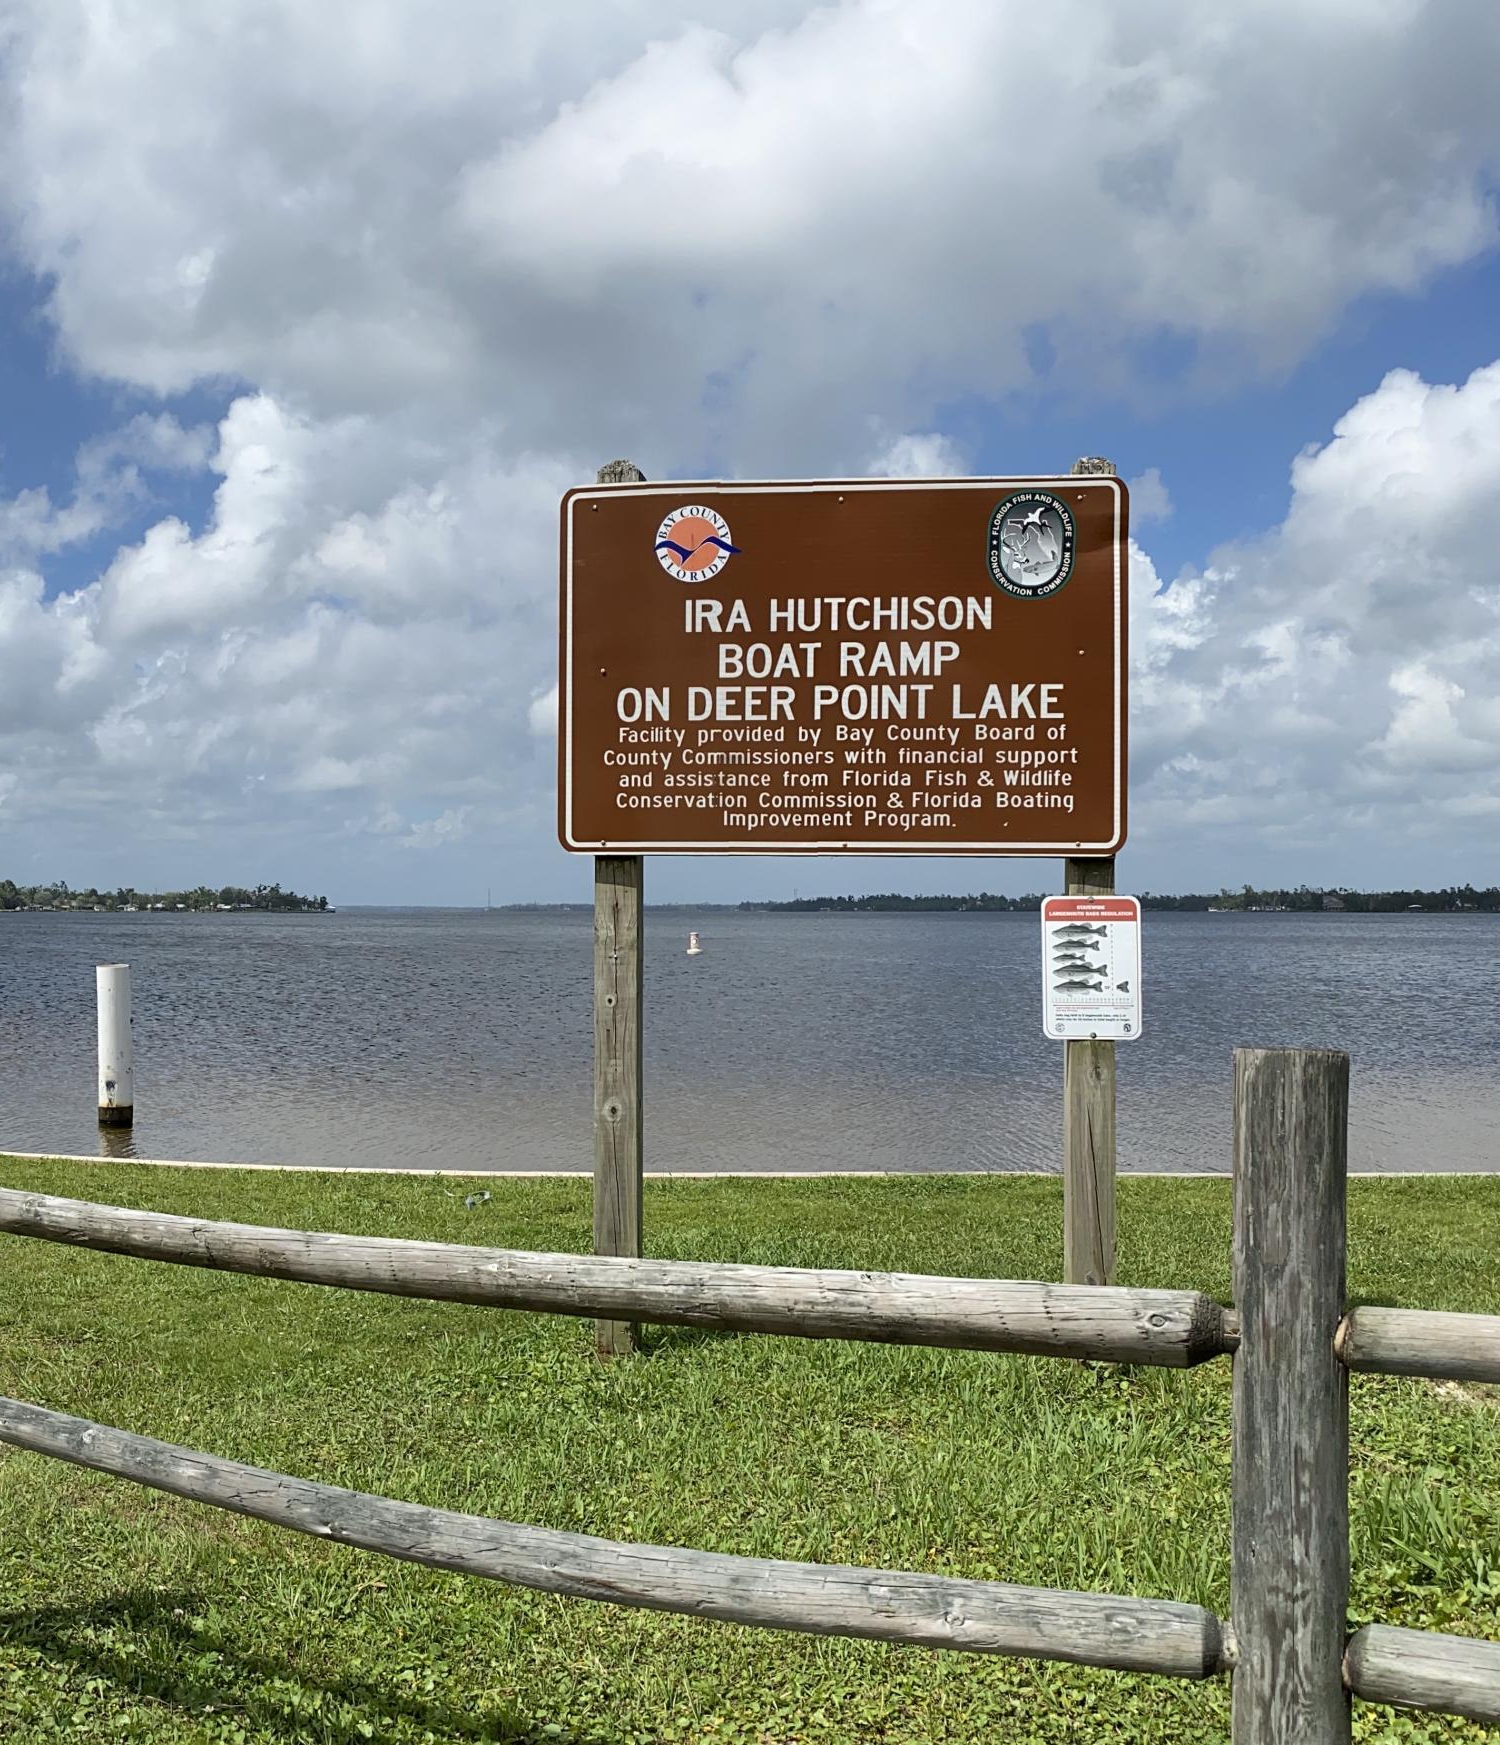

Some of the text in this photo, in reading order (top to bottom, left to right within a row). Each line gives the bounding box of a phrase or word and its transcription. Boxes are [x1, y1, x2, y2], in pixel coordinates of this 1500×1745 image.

[658, 507, 729, 540] BAY COUNTY
[992, 494, 1072, 537] FLORIDA FISH AND WILDLIFE
[660, 554, 727, 581] FLORIDA
[991, 550, 1071, 595] CONSERVATION COMMISSION
[685, 596, 992, 632] IRA HUTCHISON
[719, 641, 960, 678] BOAT RAMP
[617, 683, 1064, 722] ON DEER POINT LAKE
[619, 724, 1066, 747] Facility provided by Bay County Board of
[604, 748, 1078, 770] County Commissioners with financial support
[619, 769, 1072, 787] and assistance from Florida Fish & Wildlife
[616, 791, 1074, 813] Conservation Commission & Florida Boating
[723, 810, 957, 831] Improvement Program.
